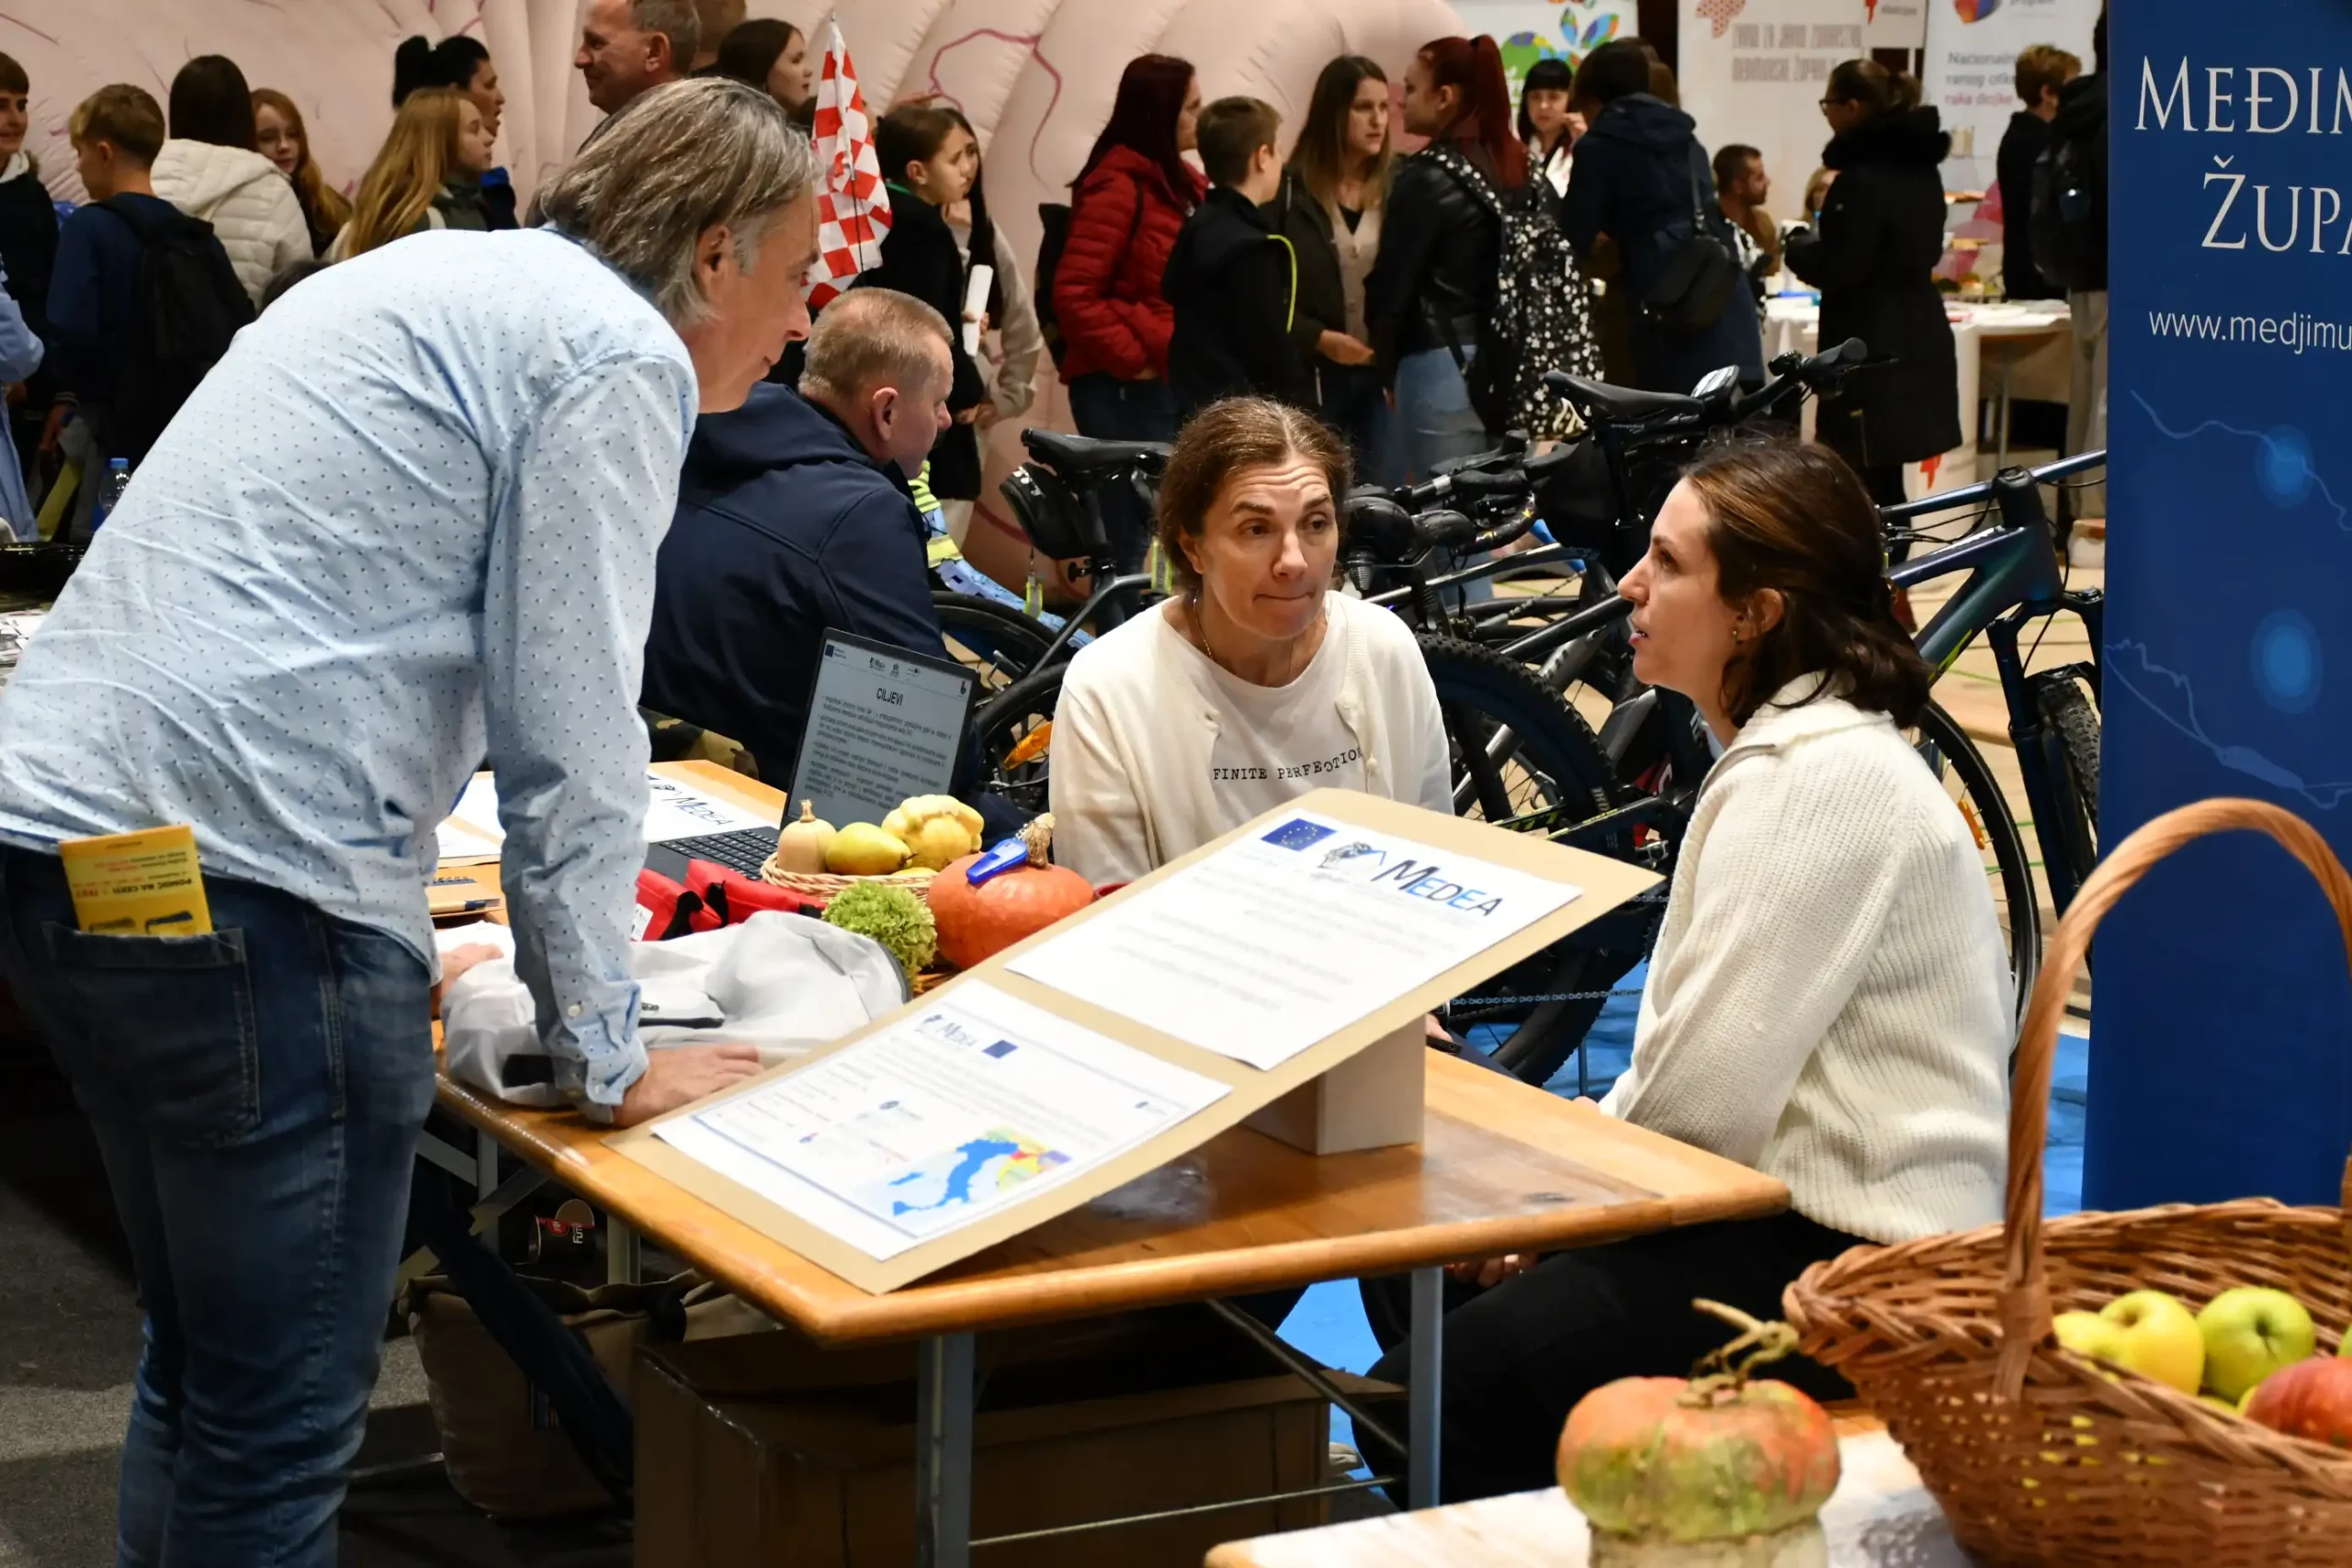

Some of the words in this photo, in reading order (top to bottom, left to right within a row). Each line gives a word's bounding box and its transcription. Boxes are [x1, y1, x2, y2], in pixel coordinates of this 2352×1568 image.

[2149, 311, 2352, 355] www.medjimu
[876, 687, 904, 706] CILJEVI
[1213, 768, 1268, 780] FINITE
[1370, 859, 1504, 917] MEDEA
